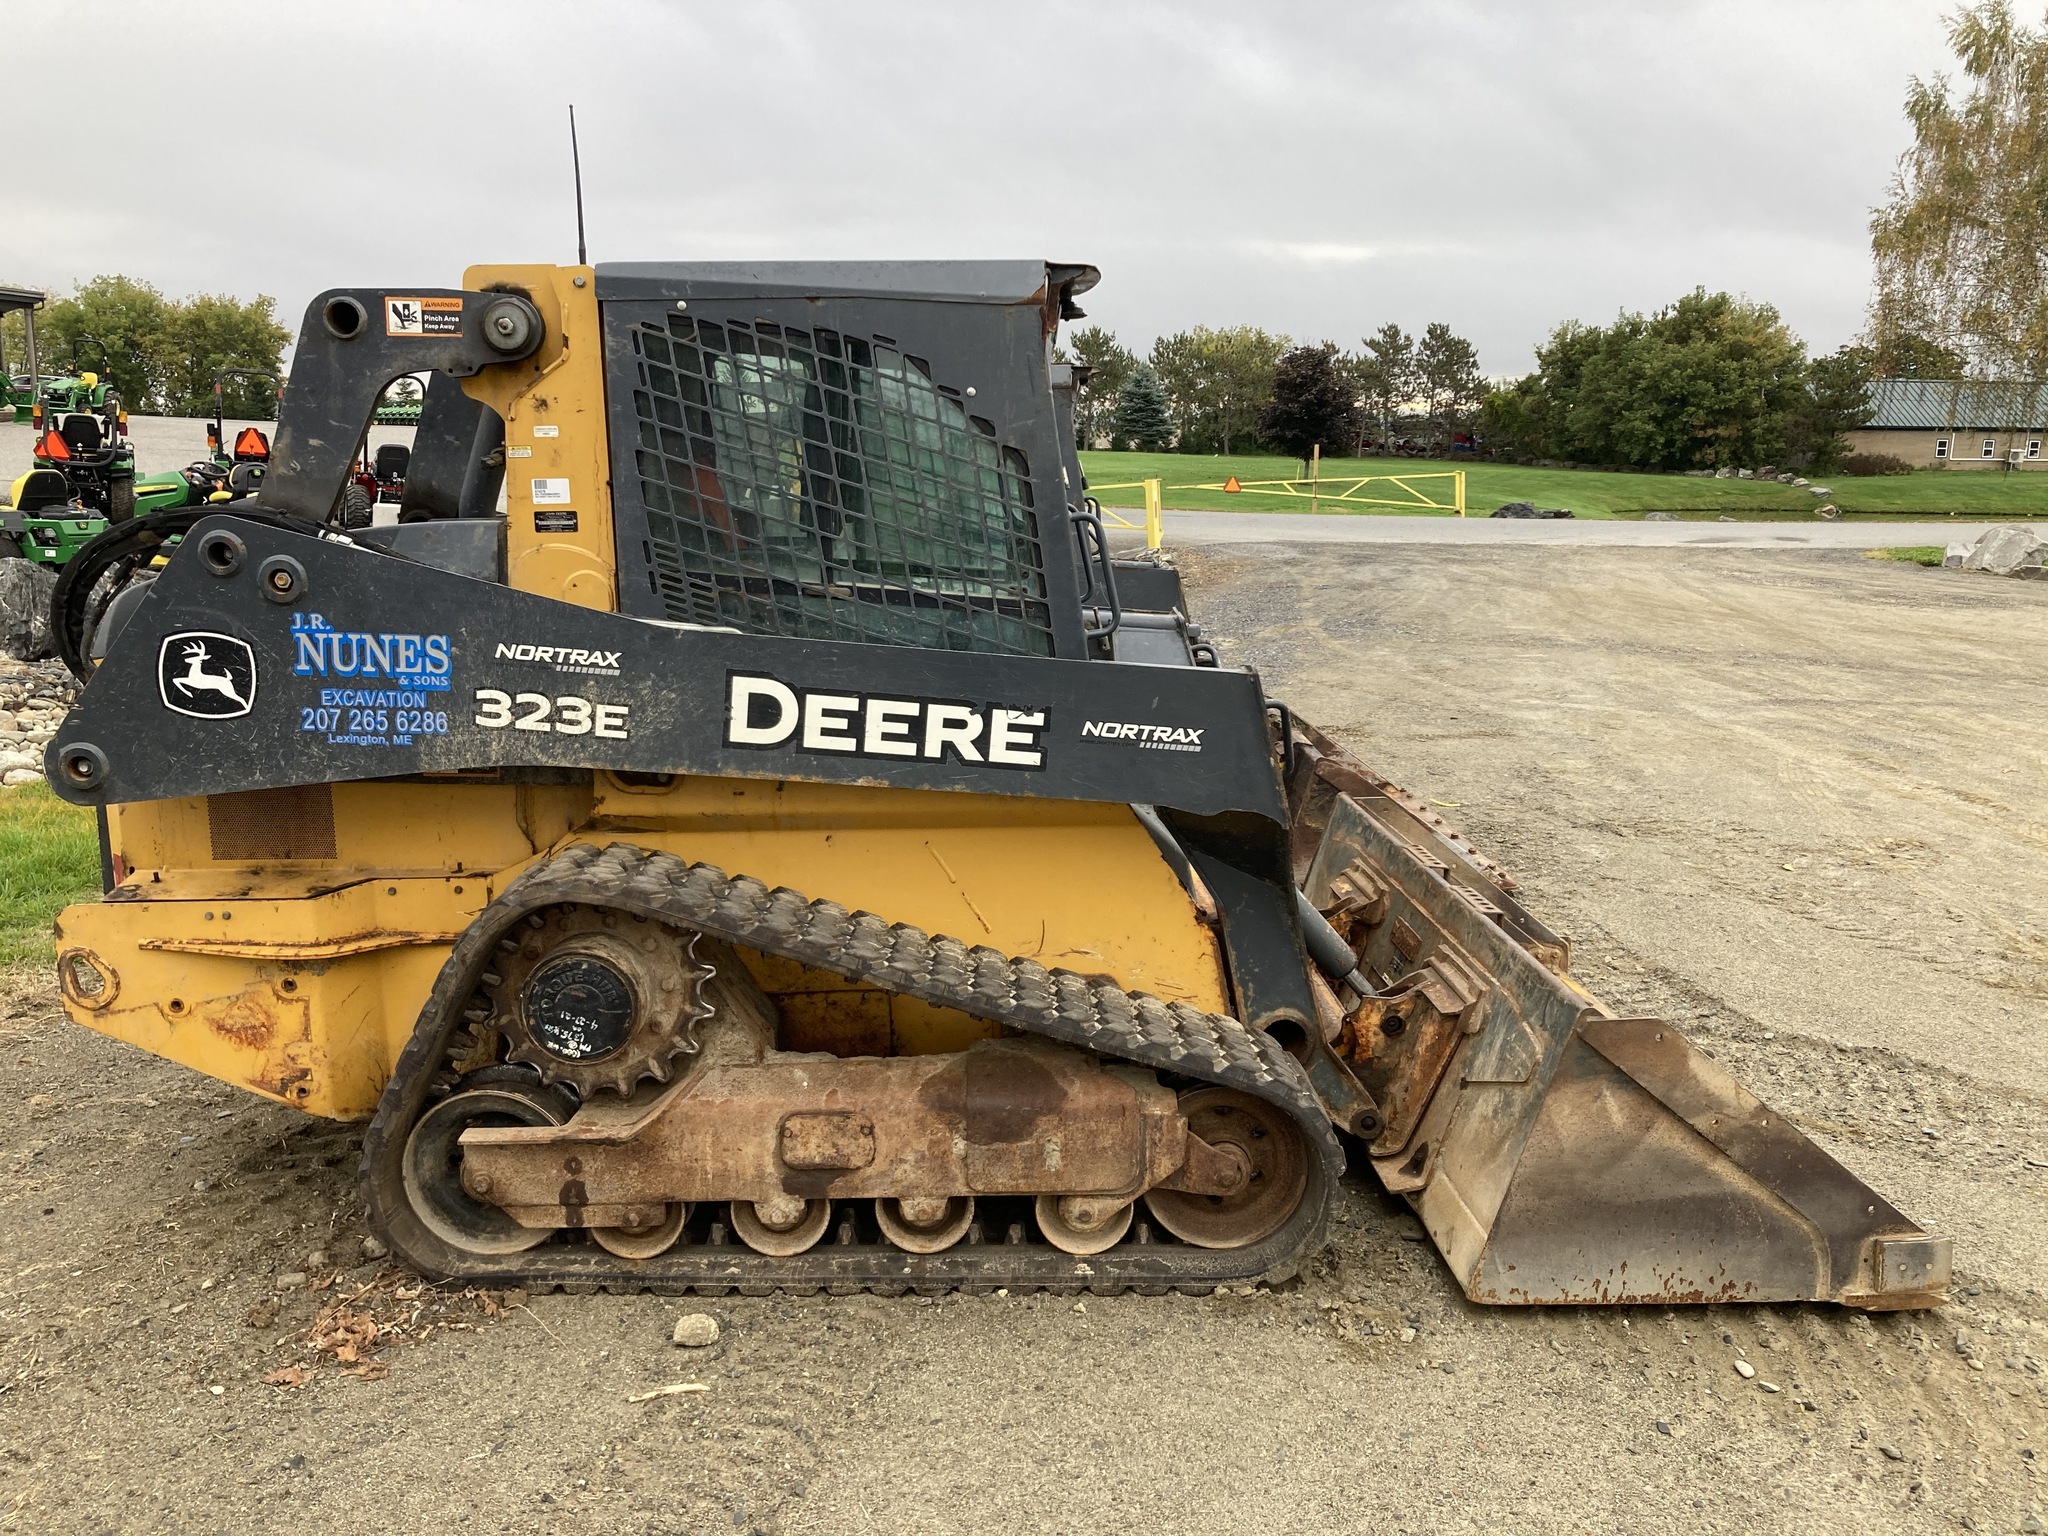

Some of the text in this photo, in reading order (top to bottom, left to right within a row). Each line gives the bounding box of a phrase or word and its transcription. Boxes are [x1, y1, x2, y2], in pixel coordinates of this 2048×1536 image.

[424, 314, 443, 322] Pinch
[440, 323, 455, 331] Away
[291, 613, 333, 630] J.R.
[294, 632, 451, 676] NUNES
[494, 642, 623, 668] NORTRAX
[400, 675, 449, 687] & SONS
[320, 689, 427, 708] EXCAVATION
[302, 707, 448, 734] 207 265 6286
[475, 689, 629, 739] 323E
[728, 676, 1045, 766] DEERE
[328, 733, 413, 746] Lexington, ME
[1081, 721, 1205, 745] NORTRAX
